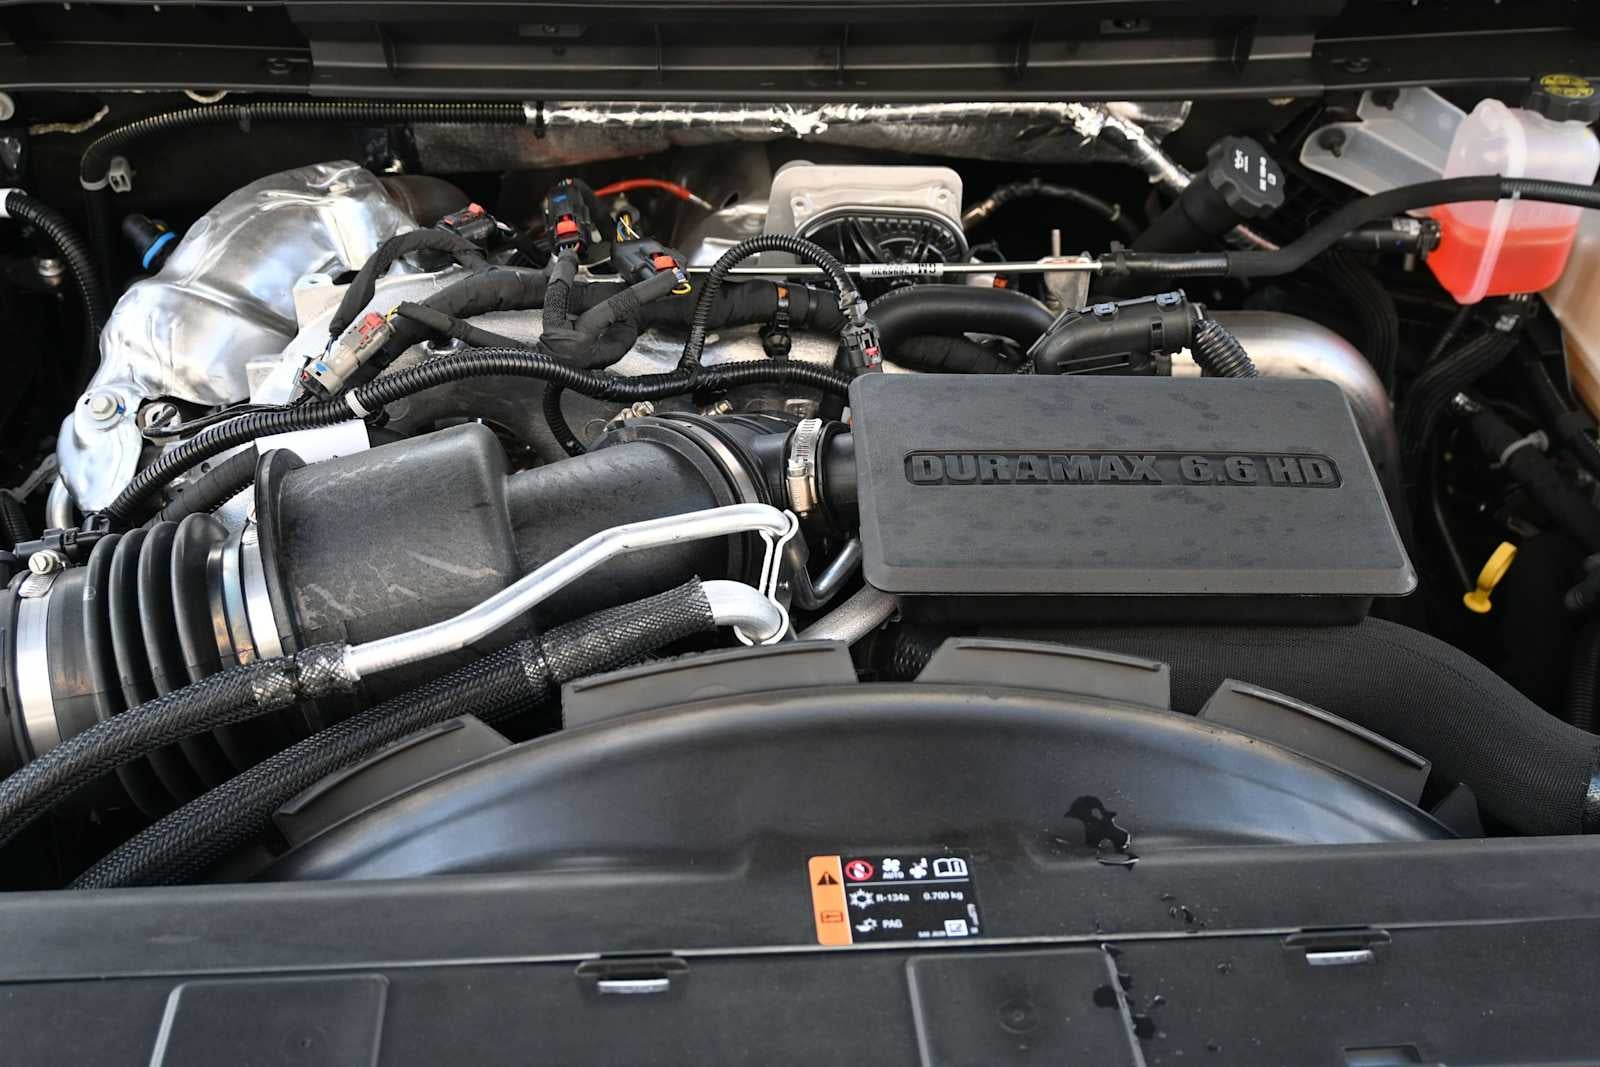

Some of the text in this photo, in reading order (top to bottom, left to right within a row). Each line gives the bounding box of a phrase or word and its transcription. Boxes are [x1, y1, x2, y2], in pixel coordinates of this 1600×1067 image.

[911, 454, 1334, 484] DURAMAX 6.6 HD
[882, 871, 904, 880] AUTO
[875, 892, 911, 902] R-134a
[951, 890, 964, 901] kg
